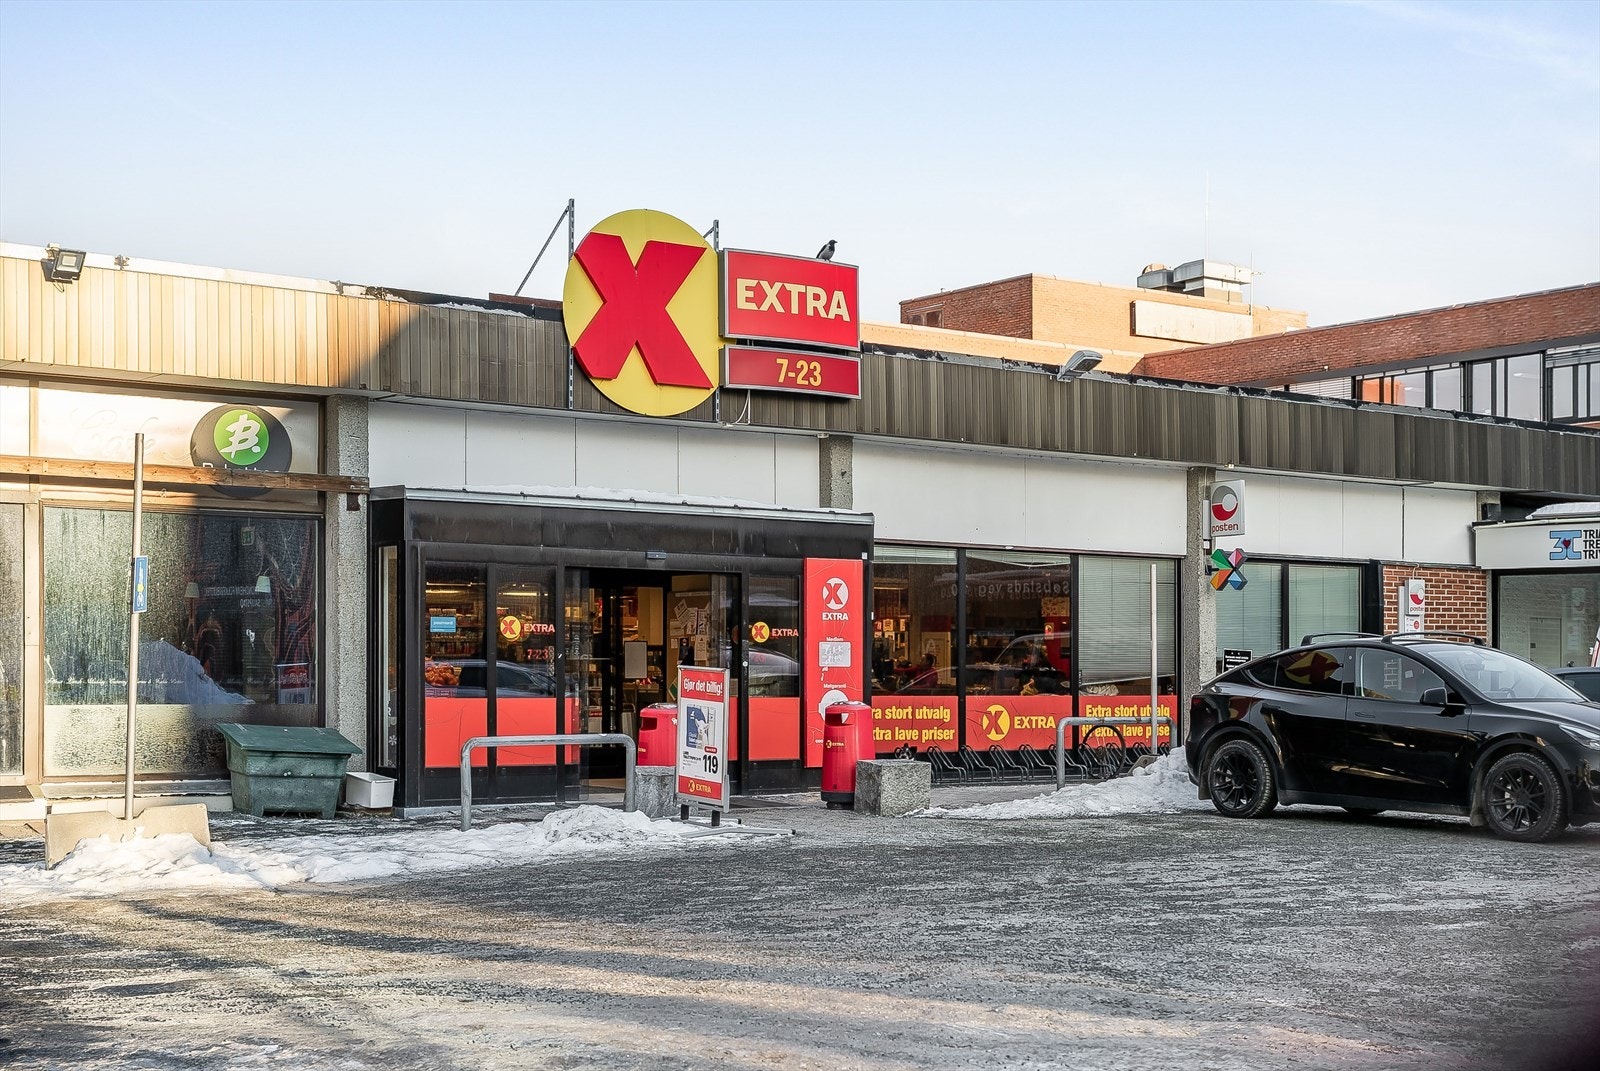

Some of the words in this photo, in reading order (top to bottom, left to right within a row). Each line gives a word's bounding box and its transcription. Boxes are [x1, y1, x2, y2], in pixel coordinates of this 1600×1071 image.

[736, 278, 850, 322] EXTRA
[776, 358, 822, 387] 7-23
[1211, 523, 1239, 534] posten
[822, 612, 849, 620] EXTRA
[523, 623, 556, 633] EXTRA
[771, 628, 799, 637] EXTRA
[683, 678, 696, 692] Gjør
[696, 680, 706, 692] det
[885, 706, 913, 720] stort
[915, 706, 951, 722] utvalg
[1086, 704, 1112, 718] Extra
[1114, 704, 1138, 718] stort
[1014, 716, 1057, 729] EXTRA
[895, 726, 919, 741] lave
[922, 726, 955, 743] priser
[1123, 724, 1144, 737] lave
[703, 754, 719, 774] 119
[696, 783, 712, 793] EXTRA
